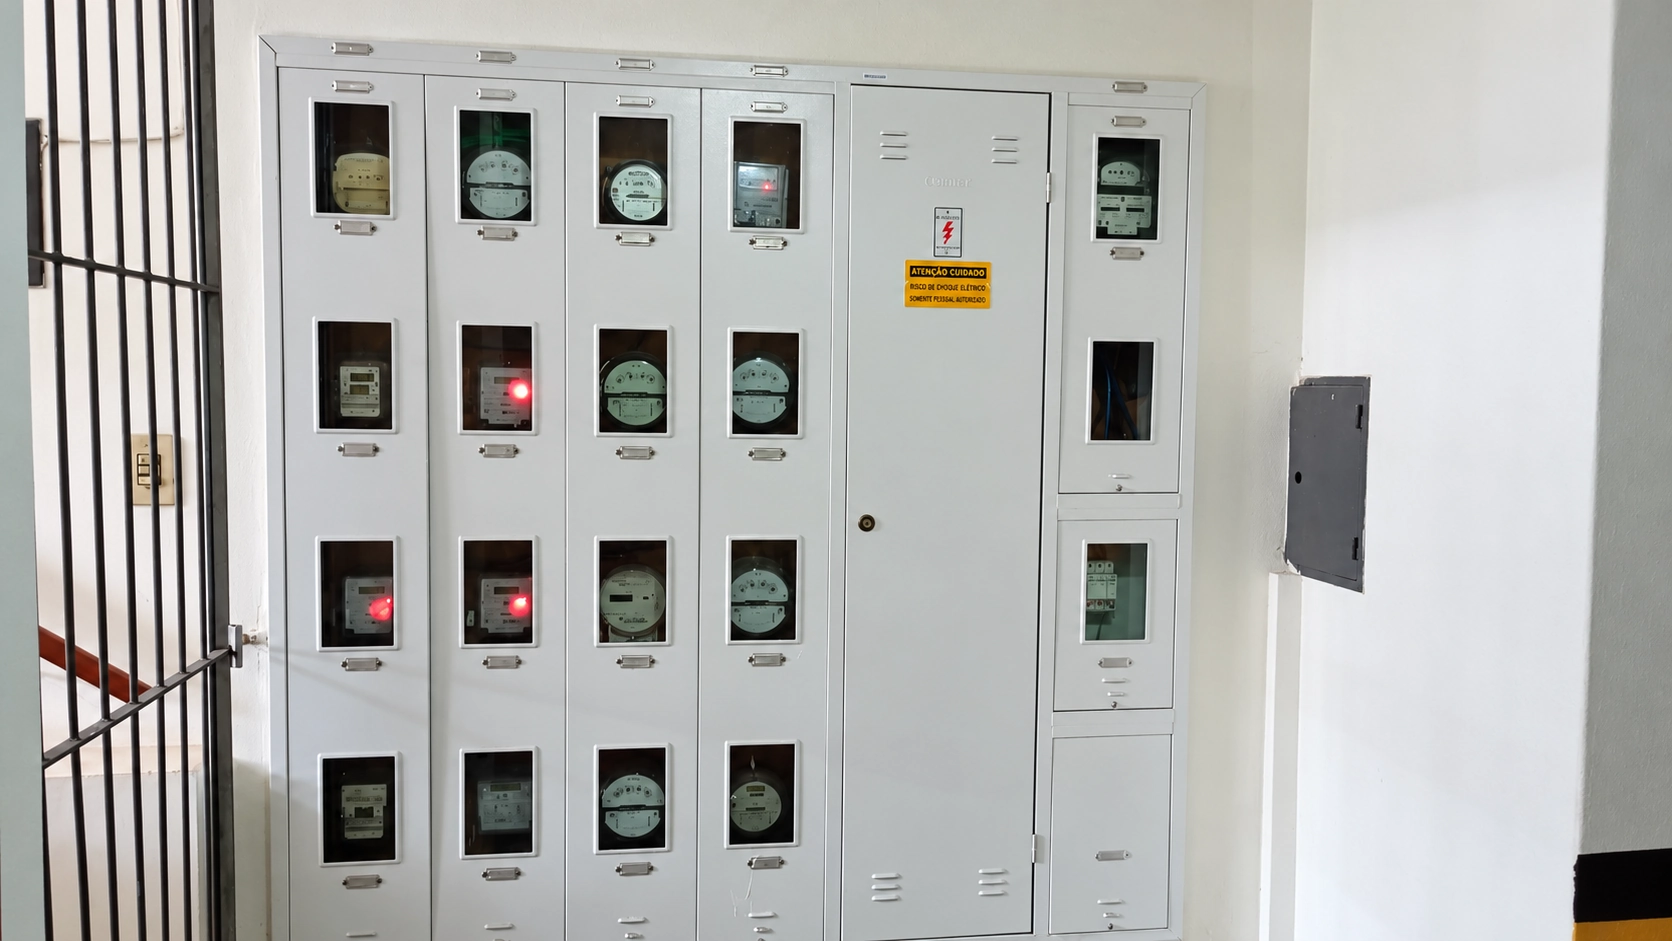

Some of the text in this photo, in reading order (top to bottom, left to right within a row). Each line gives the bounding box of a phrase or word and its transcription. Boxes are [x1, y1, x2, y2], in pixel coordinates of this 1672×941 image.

[911, 265, 985, 278] ATENÇÃO CUIDADO
[960, 284, 986, 292] ELÉTRICO
